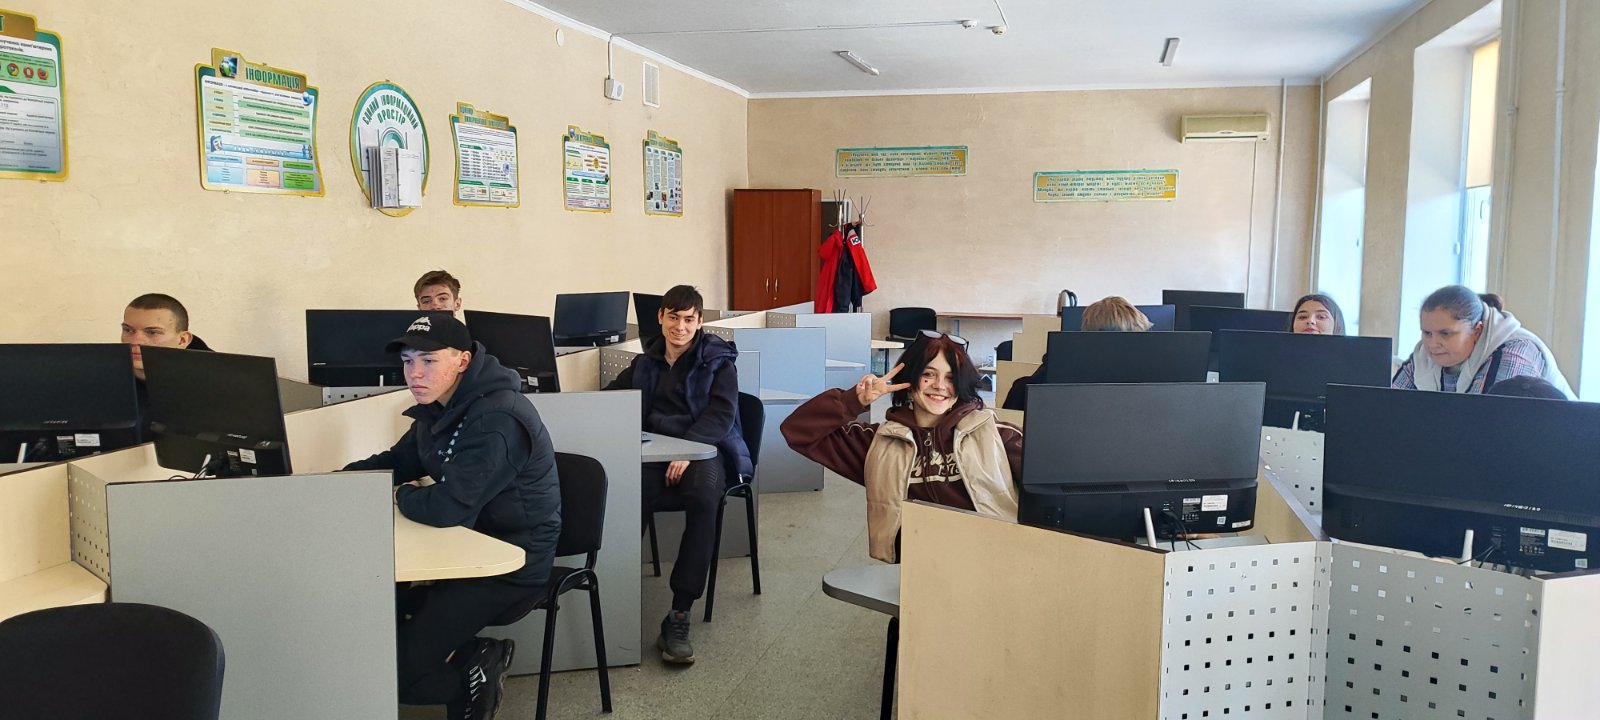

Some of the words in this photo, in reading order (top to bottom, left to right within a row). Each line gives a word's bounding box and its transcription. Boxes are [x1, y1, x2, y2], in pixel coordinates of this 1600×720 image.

[245, 67, 300, 89] ІНФОРМАЦІЯ
[362, 97, 379, 125] ЄДИНИЙ
[377, 108, 406, 125] ПРОСТІР
